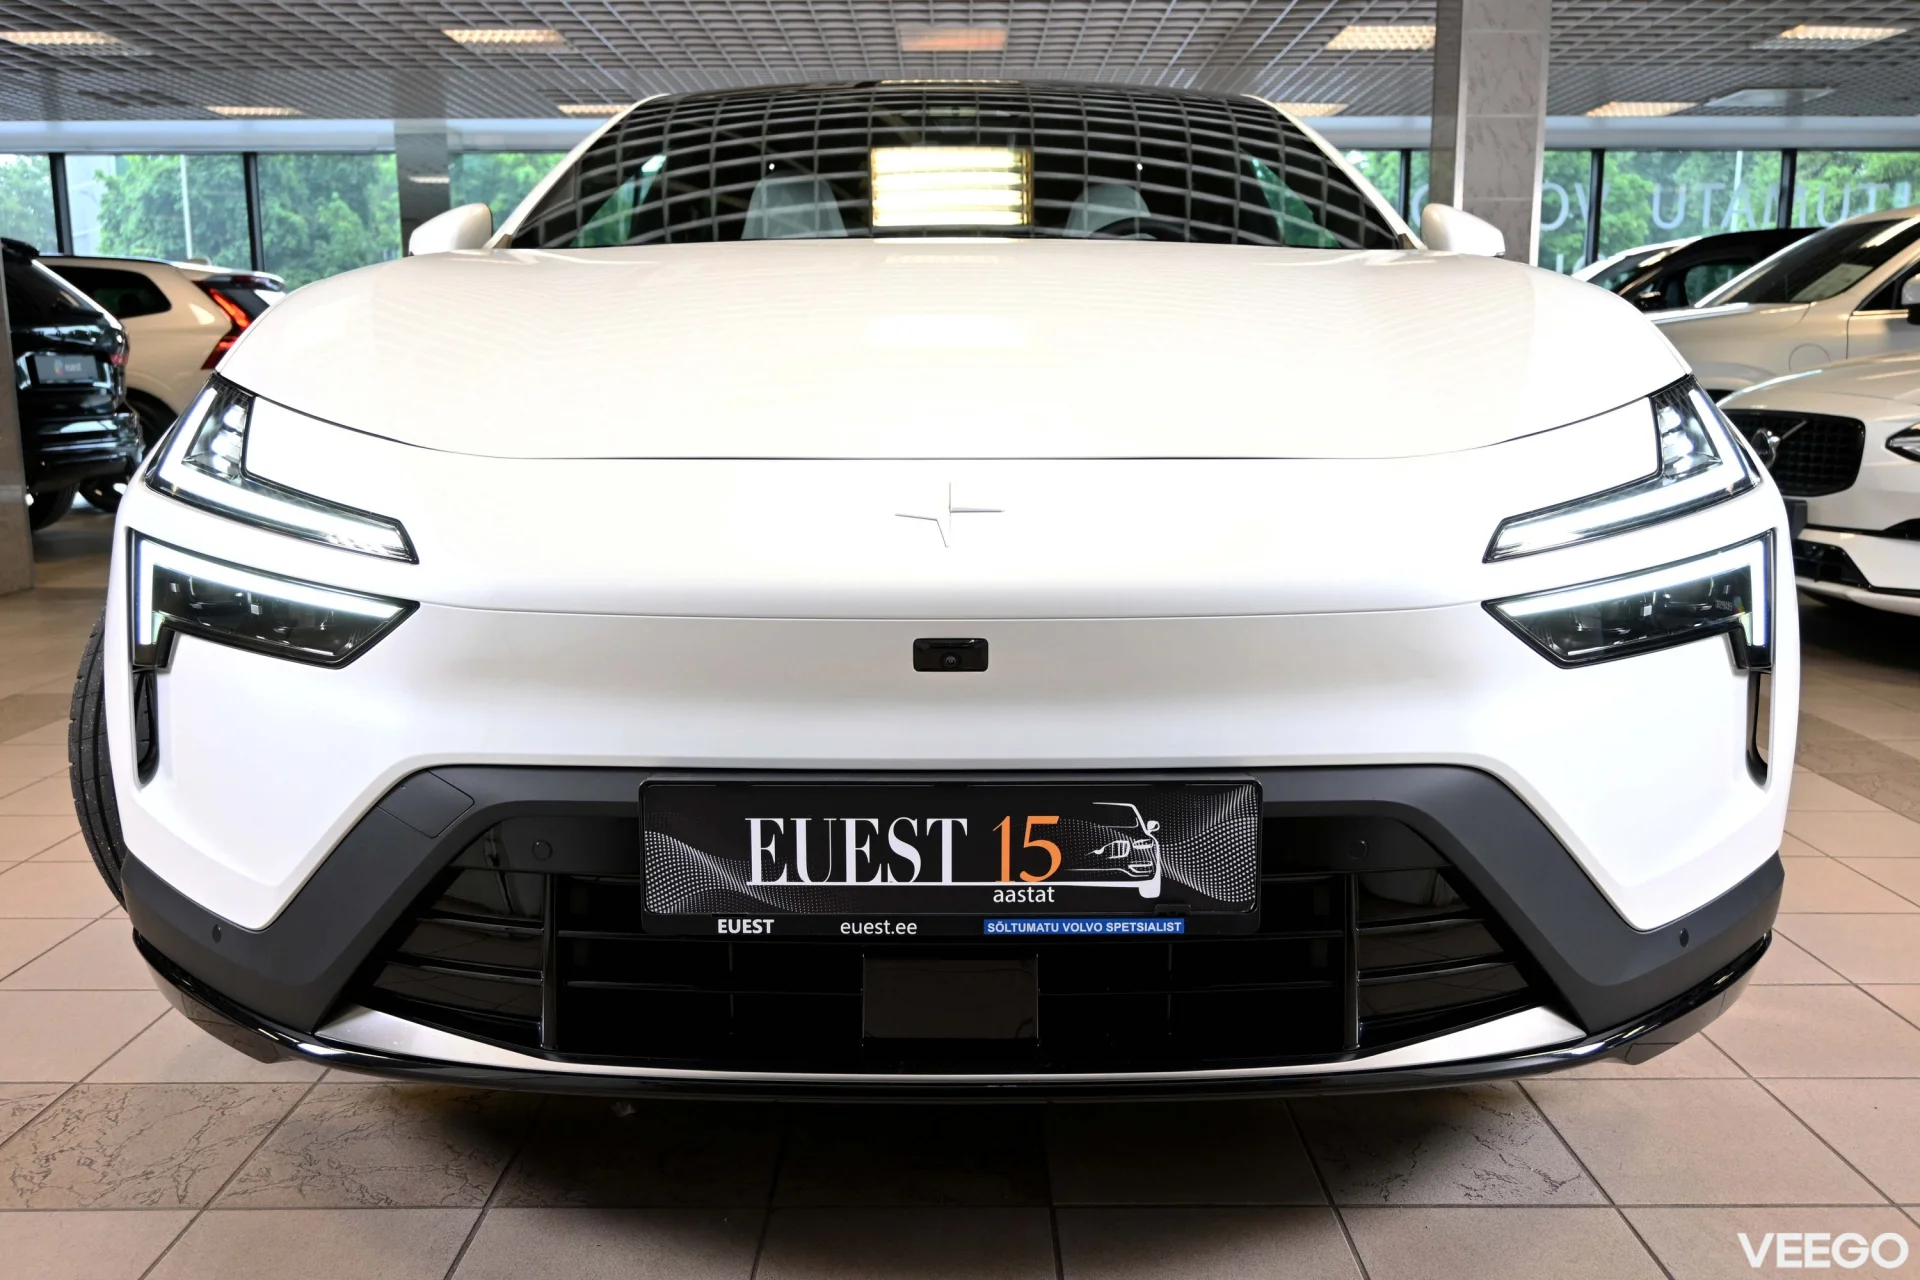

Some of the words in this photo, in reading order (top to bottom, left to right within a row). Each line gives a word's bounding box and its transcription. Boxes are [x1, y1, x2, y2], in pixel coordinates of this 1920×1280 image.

[744, 816, 968, 884] EUEST
[992, 815, 1062, 883] 15
[992, 886, 1055, 903] aastat
[717, 918, 775, 934] EUEST
[839, 919, 918, 935] euest.ee
[987, 920, 1059, 933] SÕLTUMATU
[1062, 922, 1103, 933] VOLVO
[1105, 921, 1182, 933] SPETSIALIST
